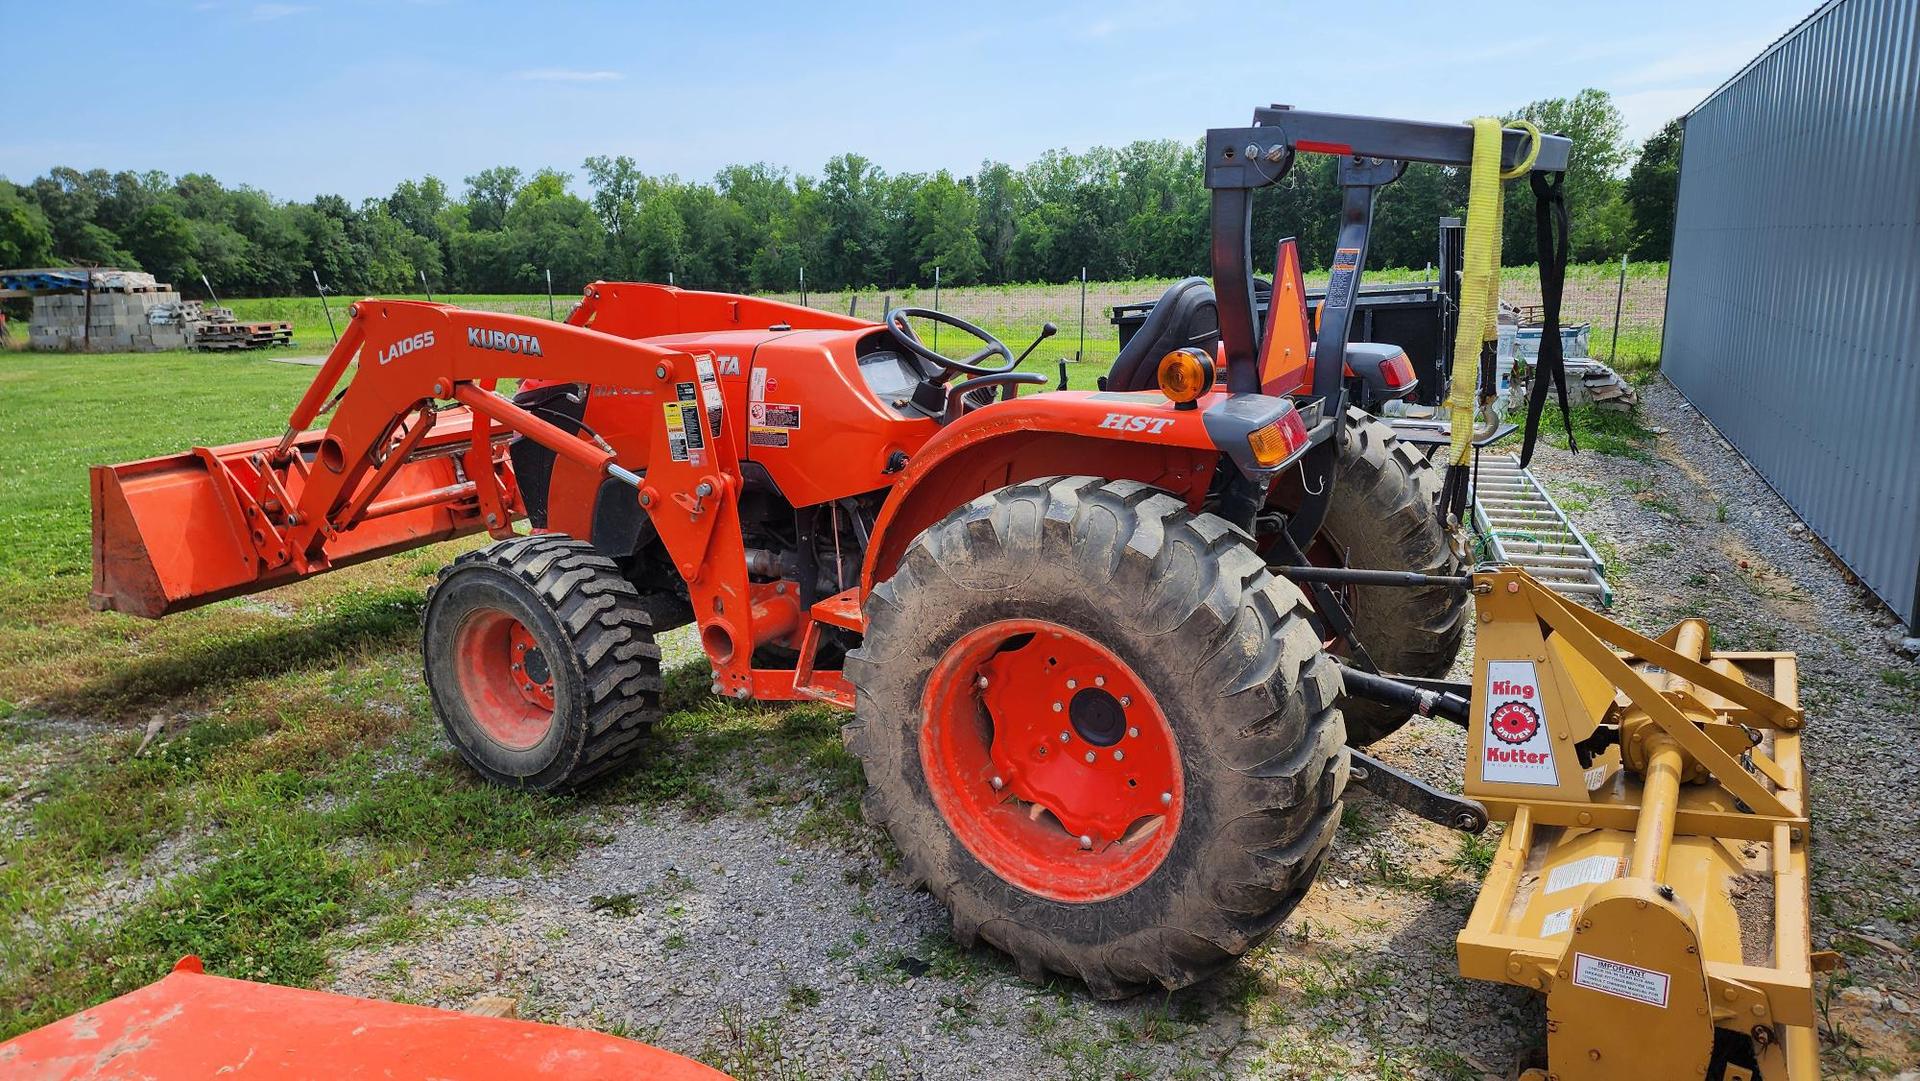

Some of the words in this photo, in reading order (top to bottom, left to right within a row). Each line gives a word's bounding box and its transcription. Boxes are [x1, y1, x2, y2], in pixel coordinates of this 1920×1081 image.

[378, 330, 435, 366] LA1065
[467, 326, 543, 357] KUBOTA
[1098, 413, 1175, 434] HST
[1493, 681, 1534, 699] King
[1496, 708, 1510, 722] ALL
[1513, 706, 1534, 723] GEAR
[1497, 727, 1531, 739] DRIVEN
[1487, 747, 1549, 764] Kutter
[1597, 961, 1645, 978] IMPORTANT
